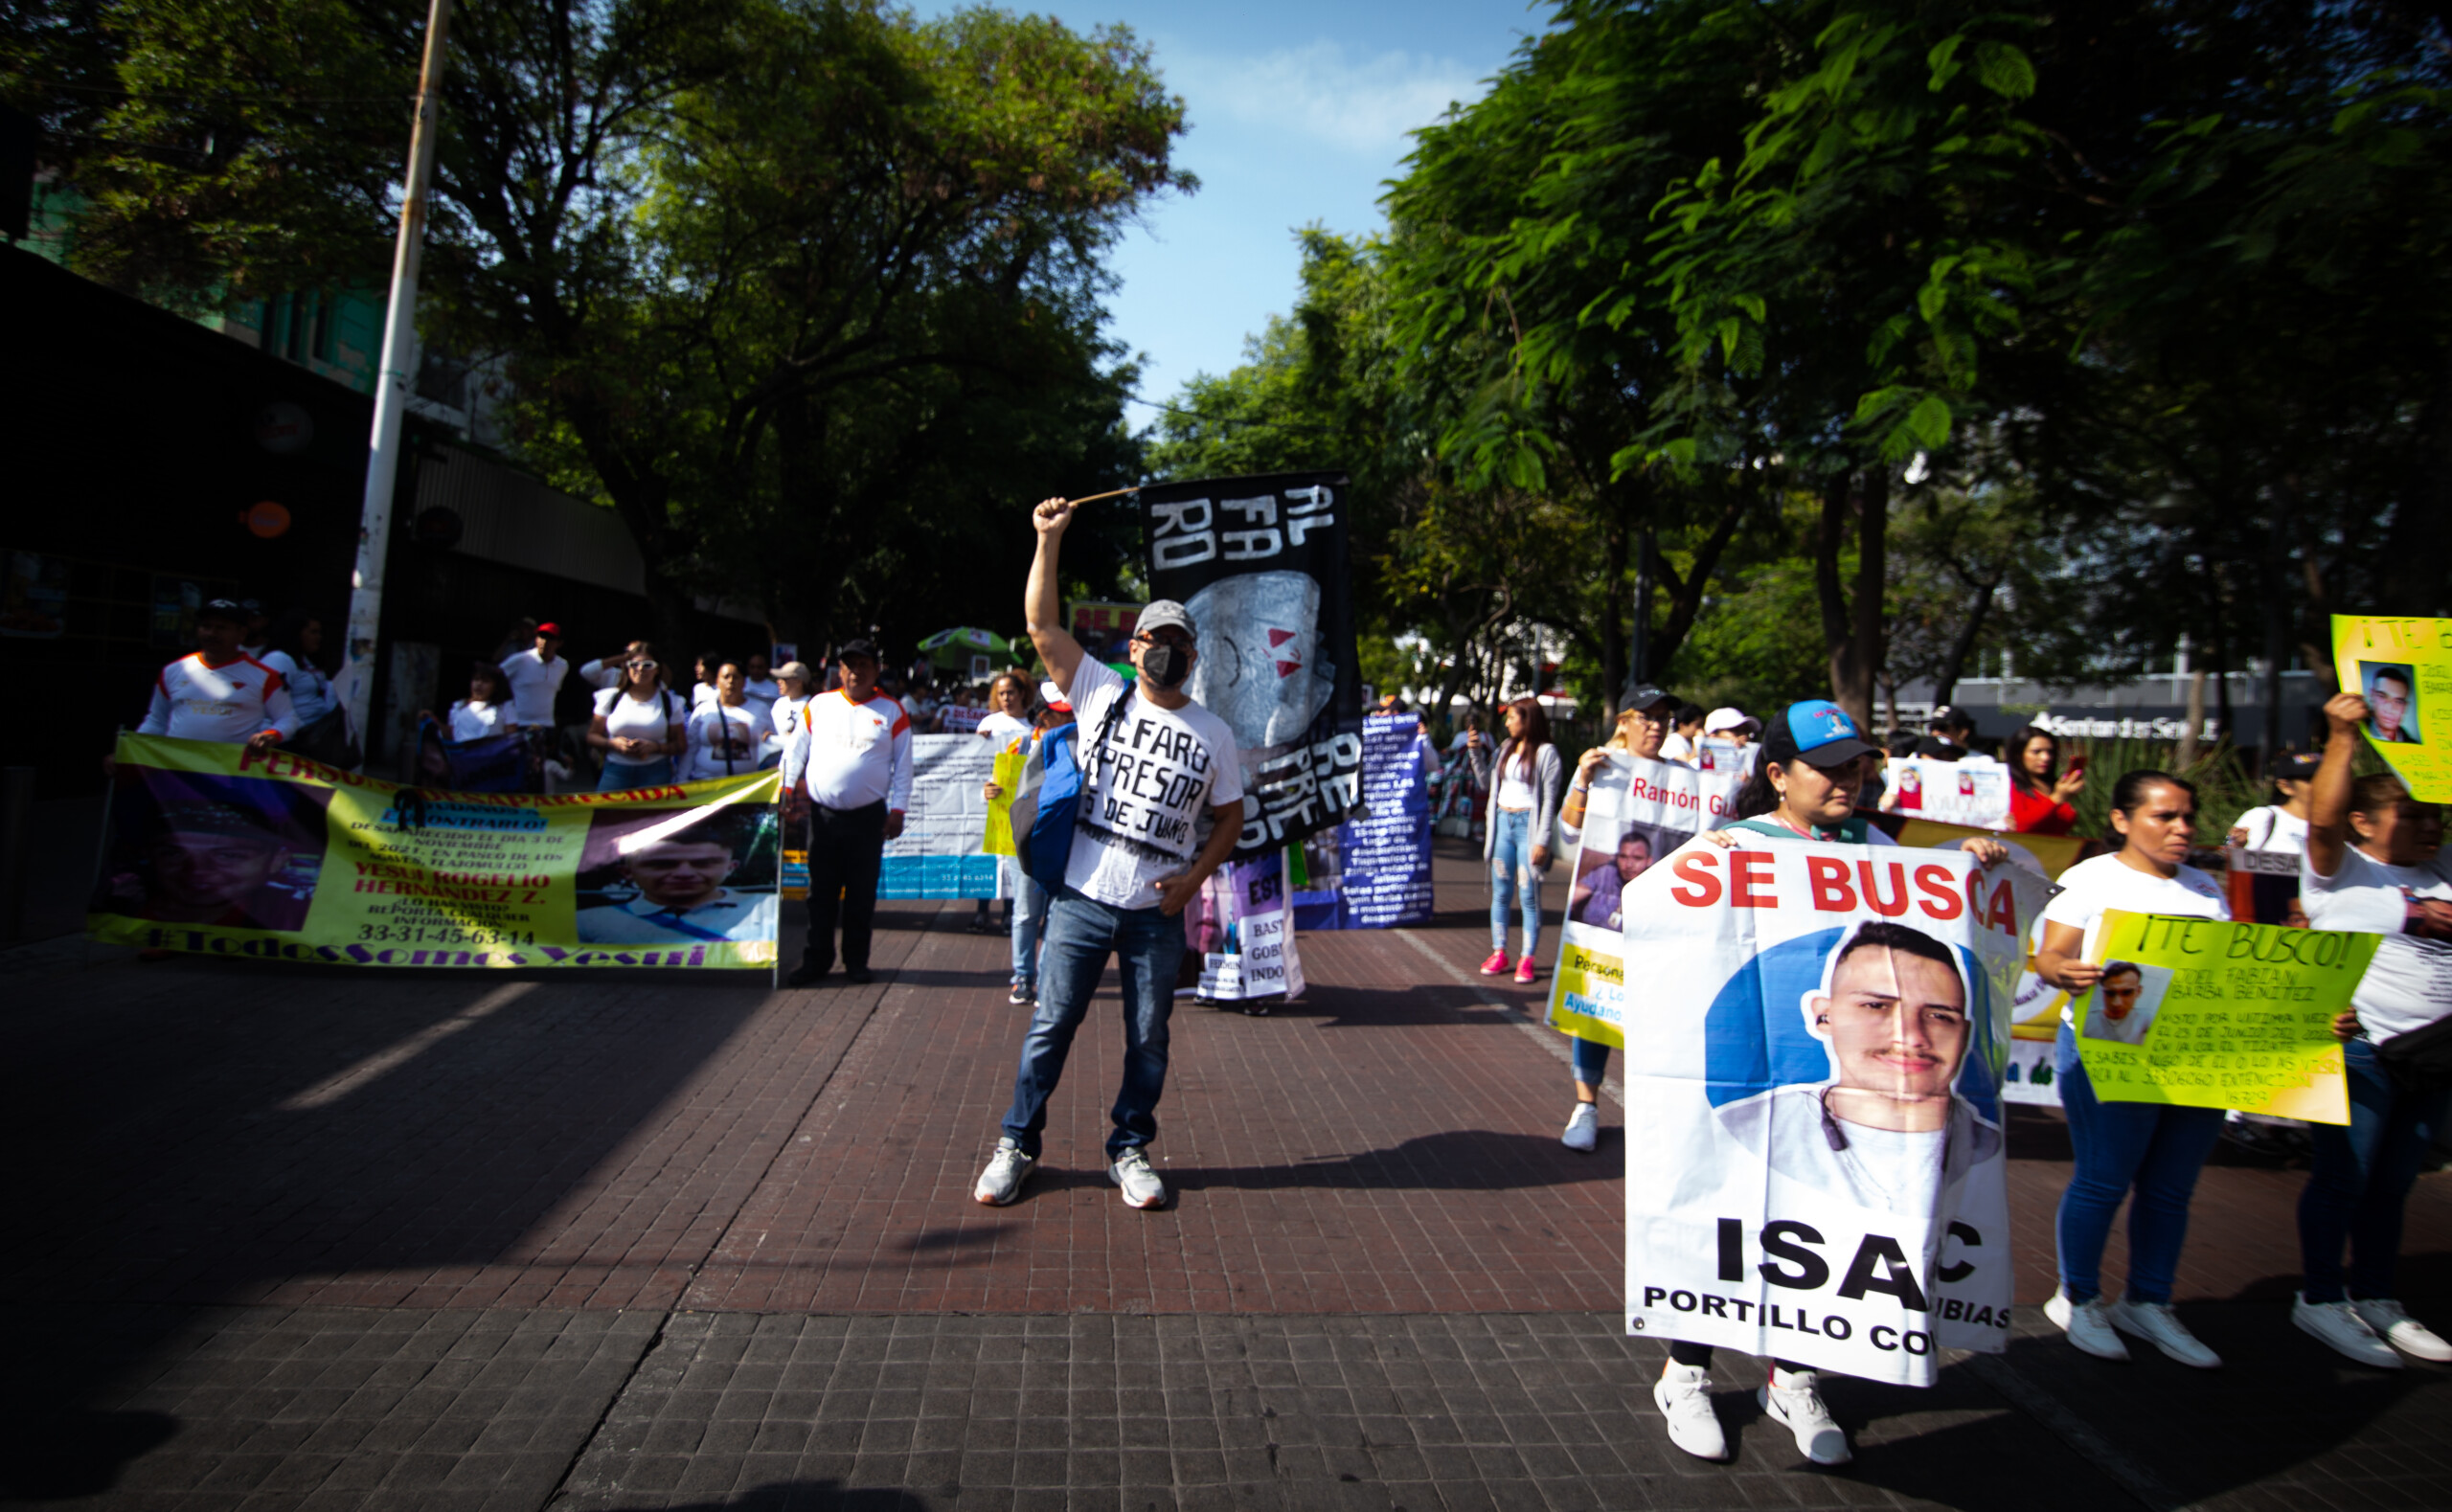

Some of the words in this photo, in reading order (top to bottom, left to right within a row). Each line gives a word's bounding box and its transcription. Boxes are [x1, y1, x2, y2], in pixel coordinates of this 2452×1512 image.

[1076, 608, 1110, 630] SE
[2050, 715, 2152, 739] Santander
[416, 784, 688, 808] DESAPARECIDA
[1632, 778, 1700, 812] Ramón
[1104, 797, 1133, 826] DE
[434, 870, 551, 889] ROGELIO
[1670, 850, 1779, 909] SE
[1806, 855, 2017, 937] BUSCA
[357, 923, 535, 946] 33-31-45-63-14
[2226, 923, 2352, 969] BUSCO!
[1716, 1217, 1983, 1313] ISAC
[1644, 1286, 1852, 1342] PORTILLO
